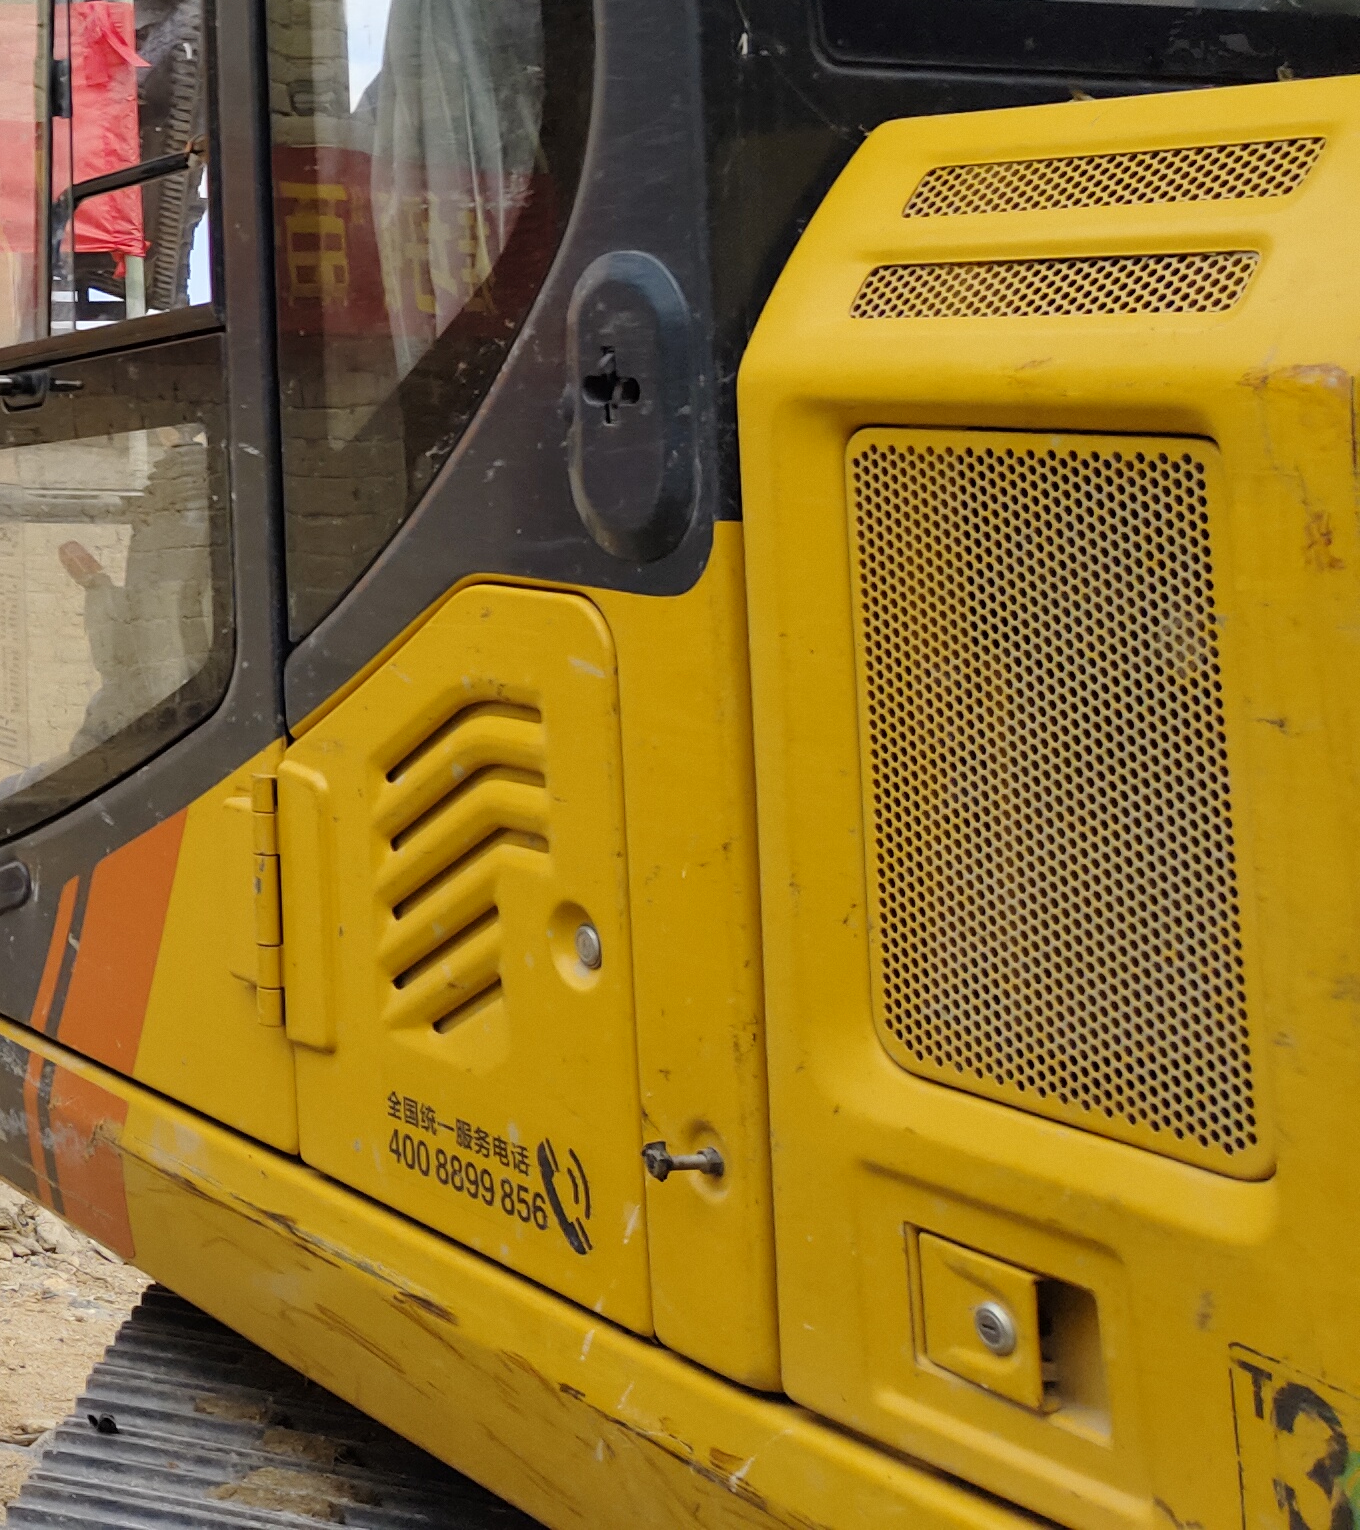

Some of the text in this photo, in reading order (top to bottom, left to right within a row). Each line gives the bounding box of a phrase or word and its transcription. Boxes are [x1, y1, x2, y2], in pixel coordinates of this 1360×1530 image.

[387, 1091, 531, 1177] 全国统一服务电话
[389, 1128, 549, 1231] 400 8899 856
